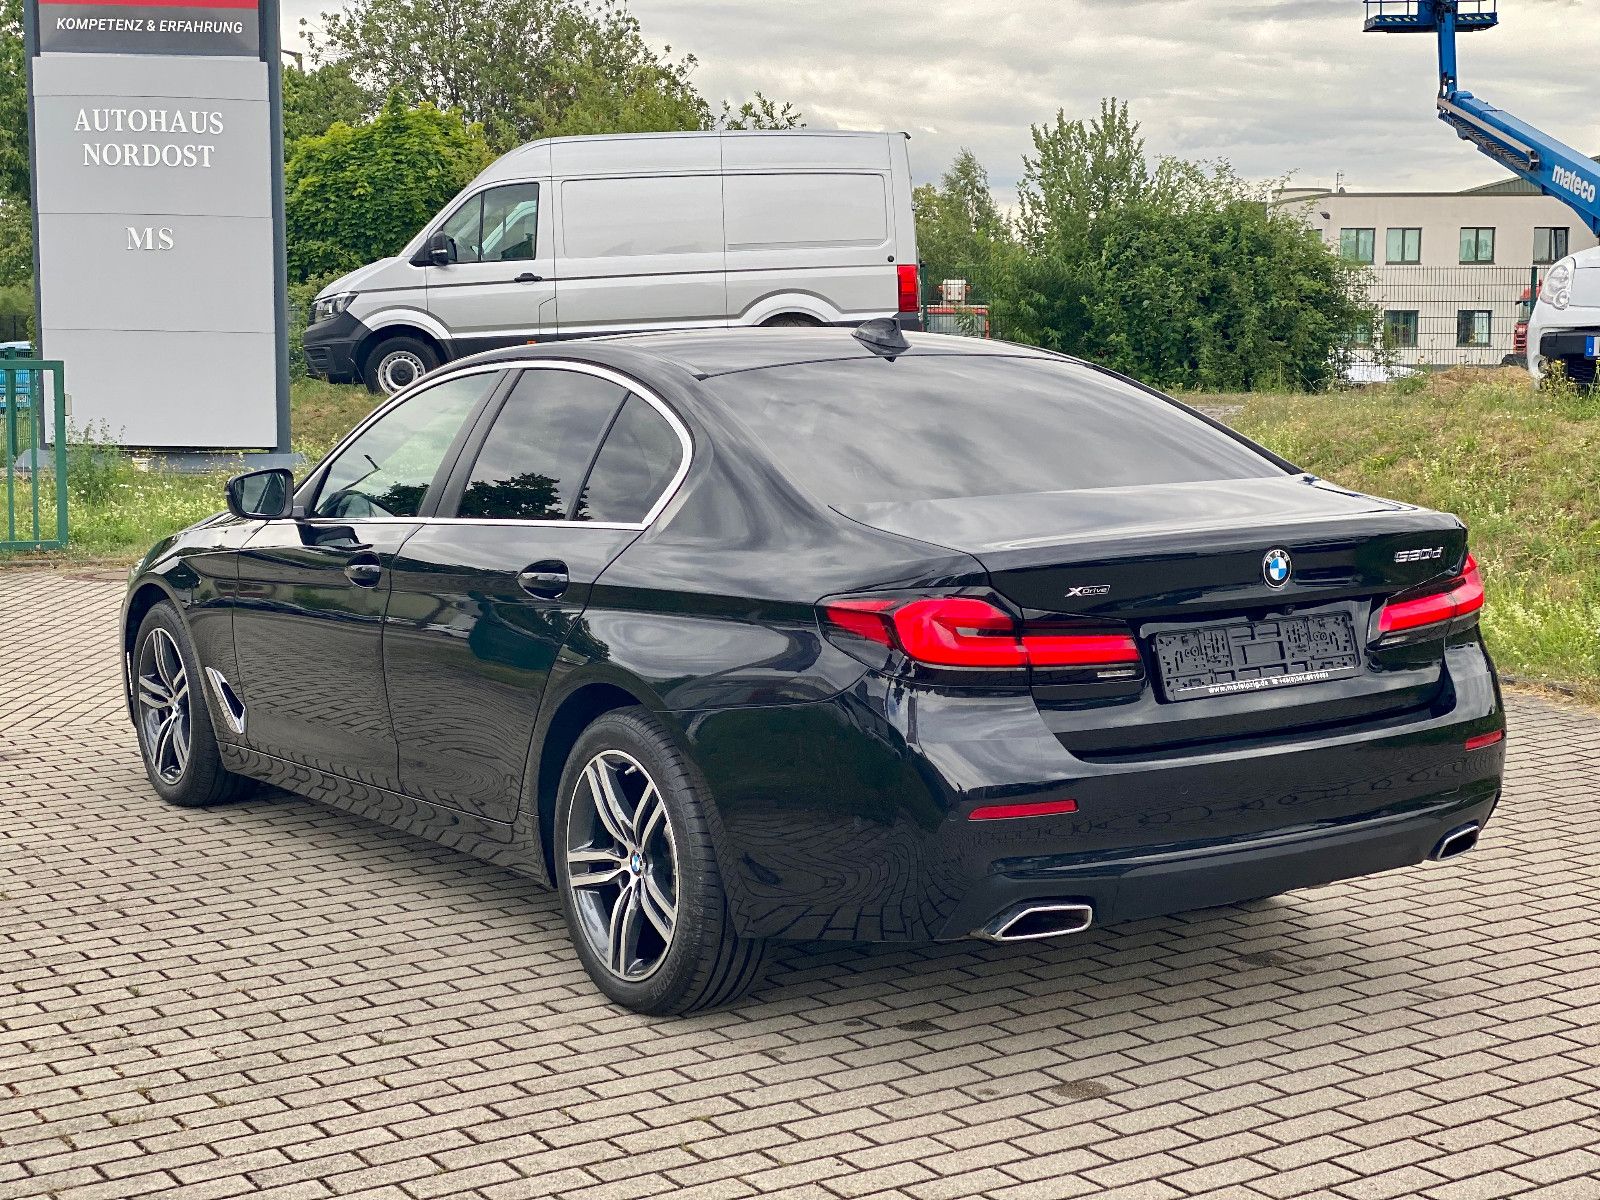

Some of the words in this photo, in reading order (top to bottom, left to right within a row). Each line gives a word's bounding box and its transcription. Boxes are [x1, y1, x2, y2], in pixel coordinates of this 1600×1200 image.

[56, 17, 143, 32] KOMPETENZ
[147, 19, 156, 32] &
[159, 20, 243, 34] ERFAHRUNG
[73, 109, 224, 135] AUTOHAUS
[83, 143, 215, 168] NORDOST
[1552, 164, 1596, 203] mateco
[125, 226, 175, 251] MS
